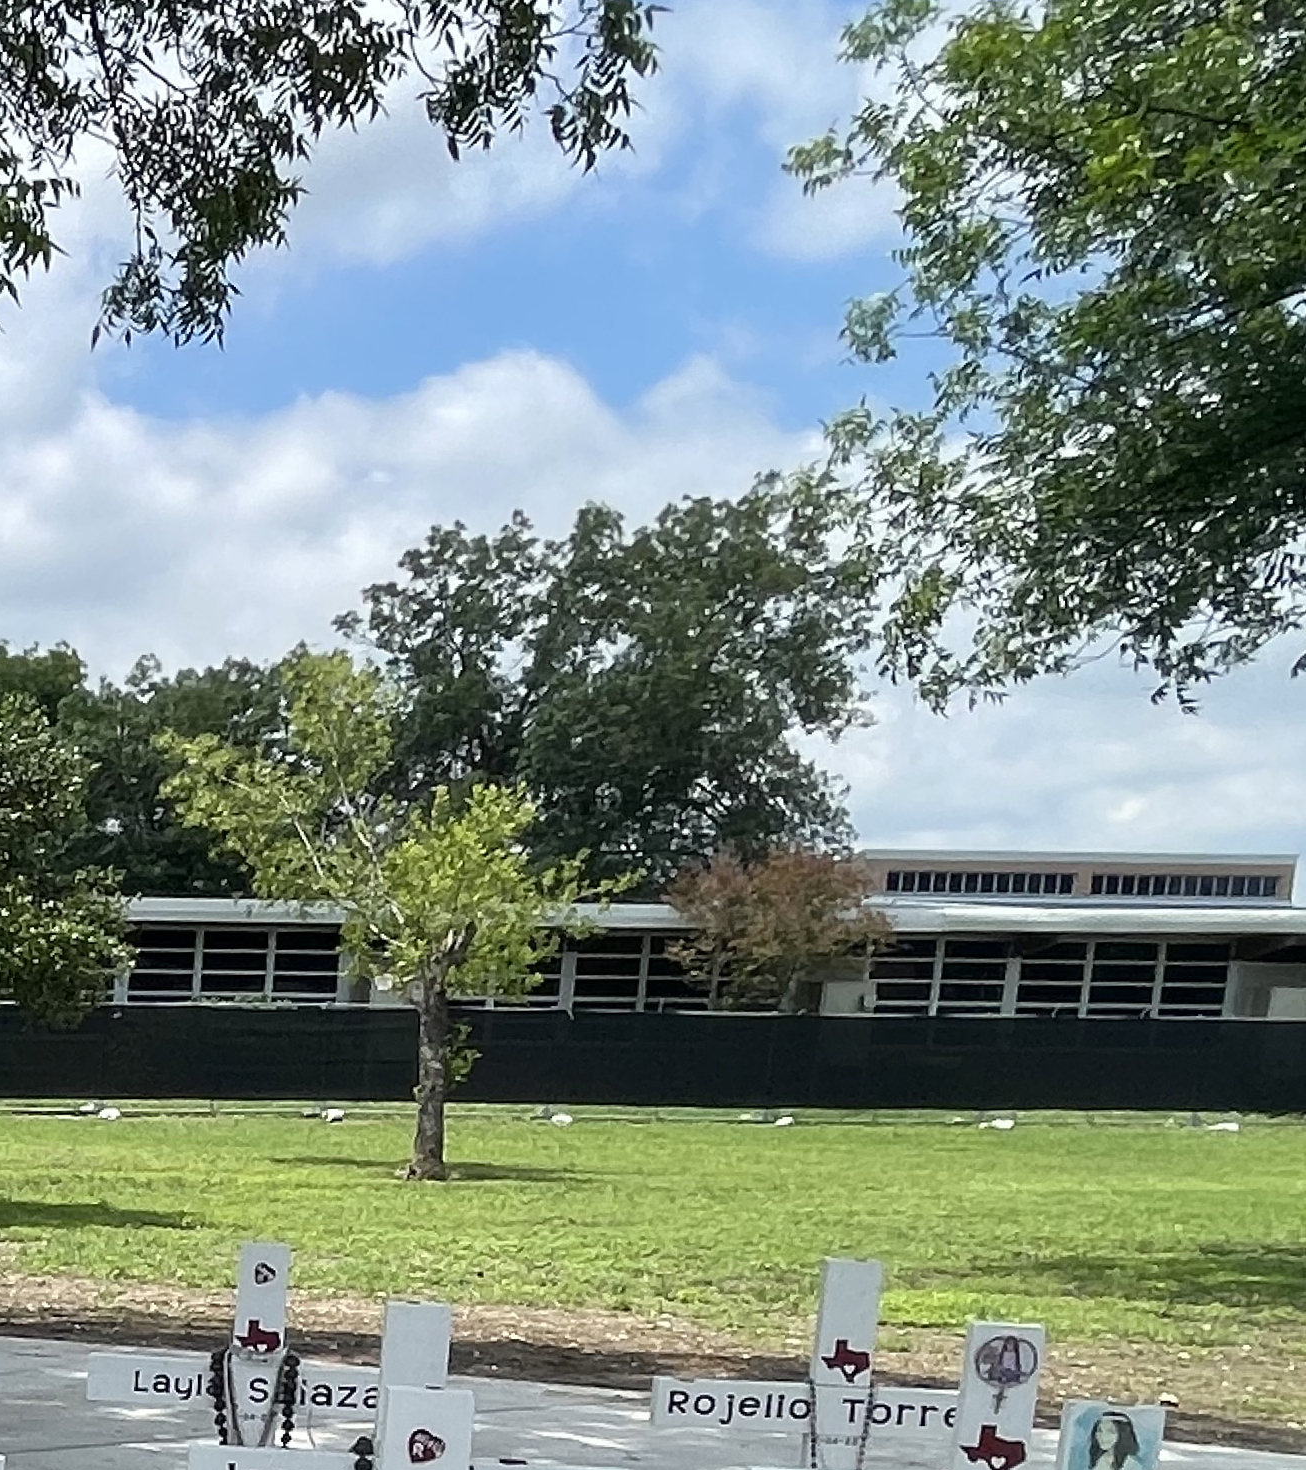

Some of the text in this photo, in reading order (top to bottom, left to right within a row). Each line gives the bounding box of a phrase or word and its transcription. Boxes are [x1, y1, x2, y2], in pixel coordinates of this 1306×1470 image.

[133, 1370, 209, 1400] Layl
[668, 1390, 957, 1428] Rojelio Torre
